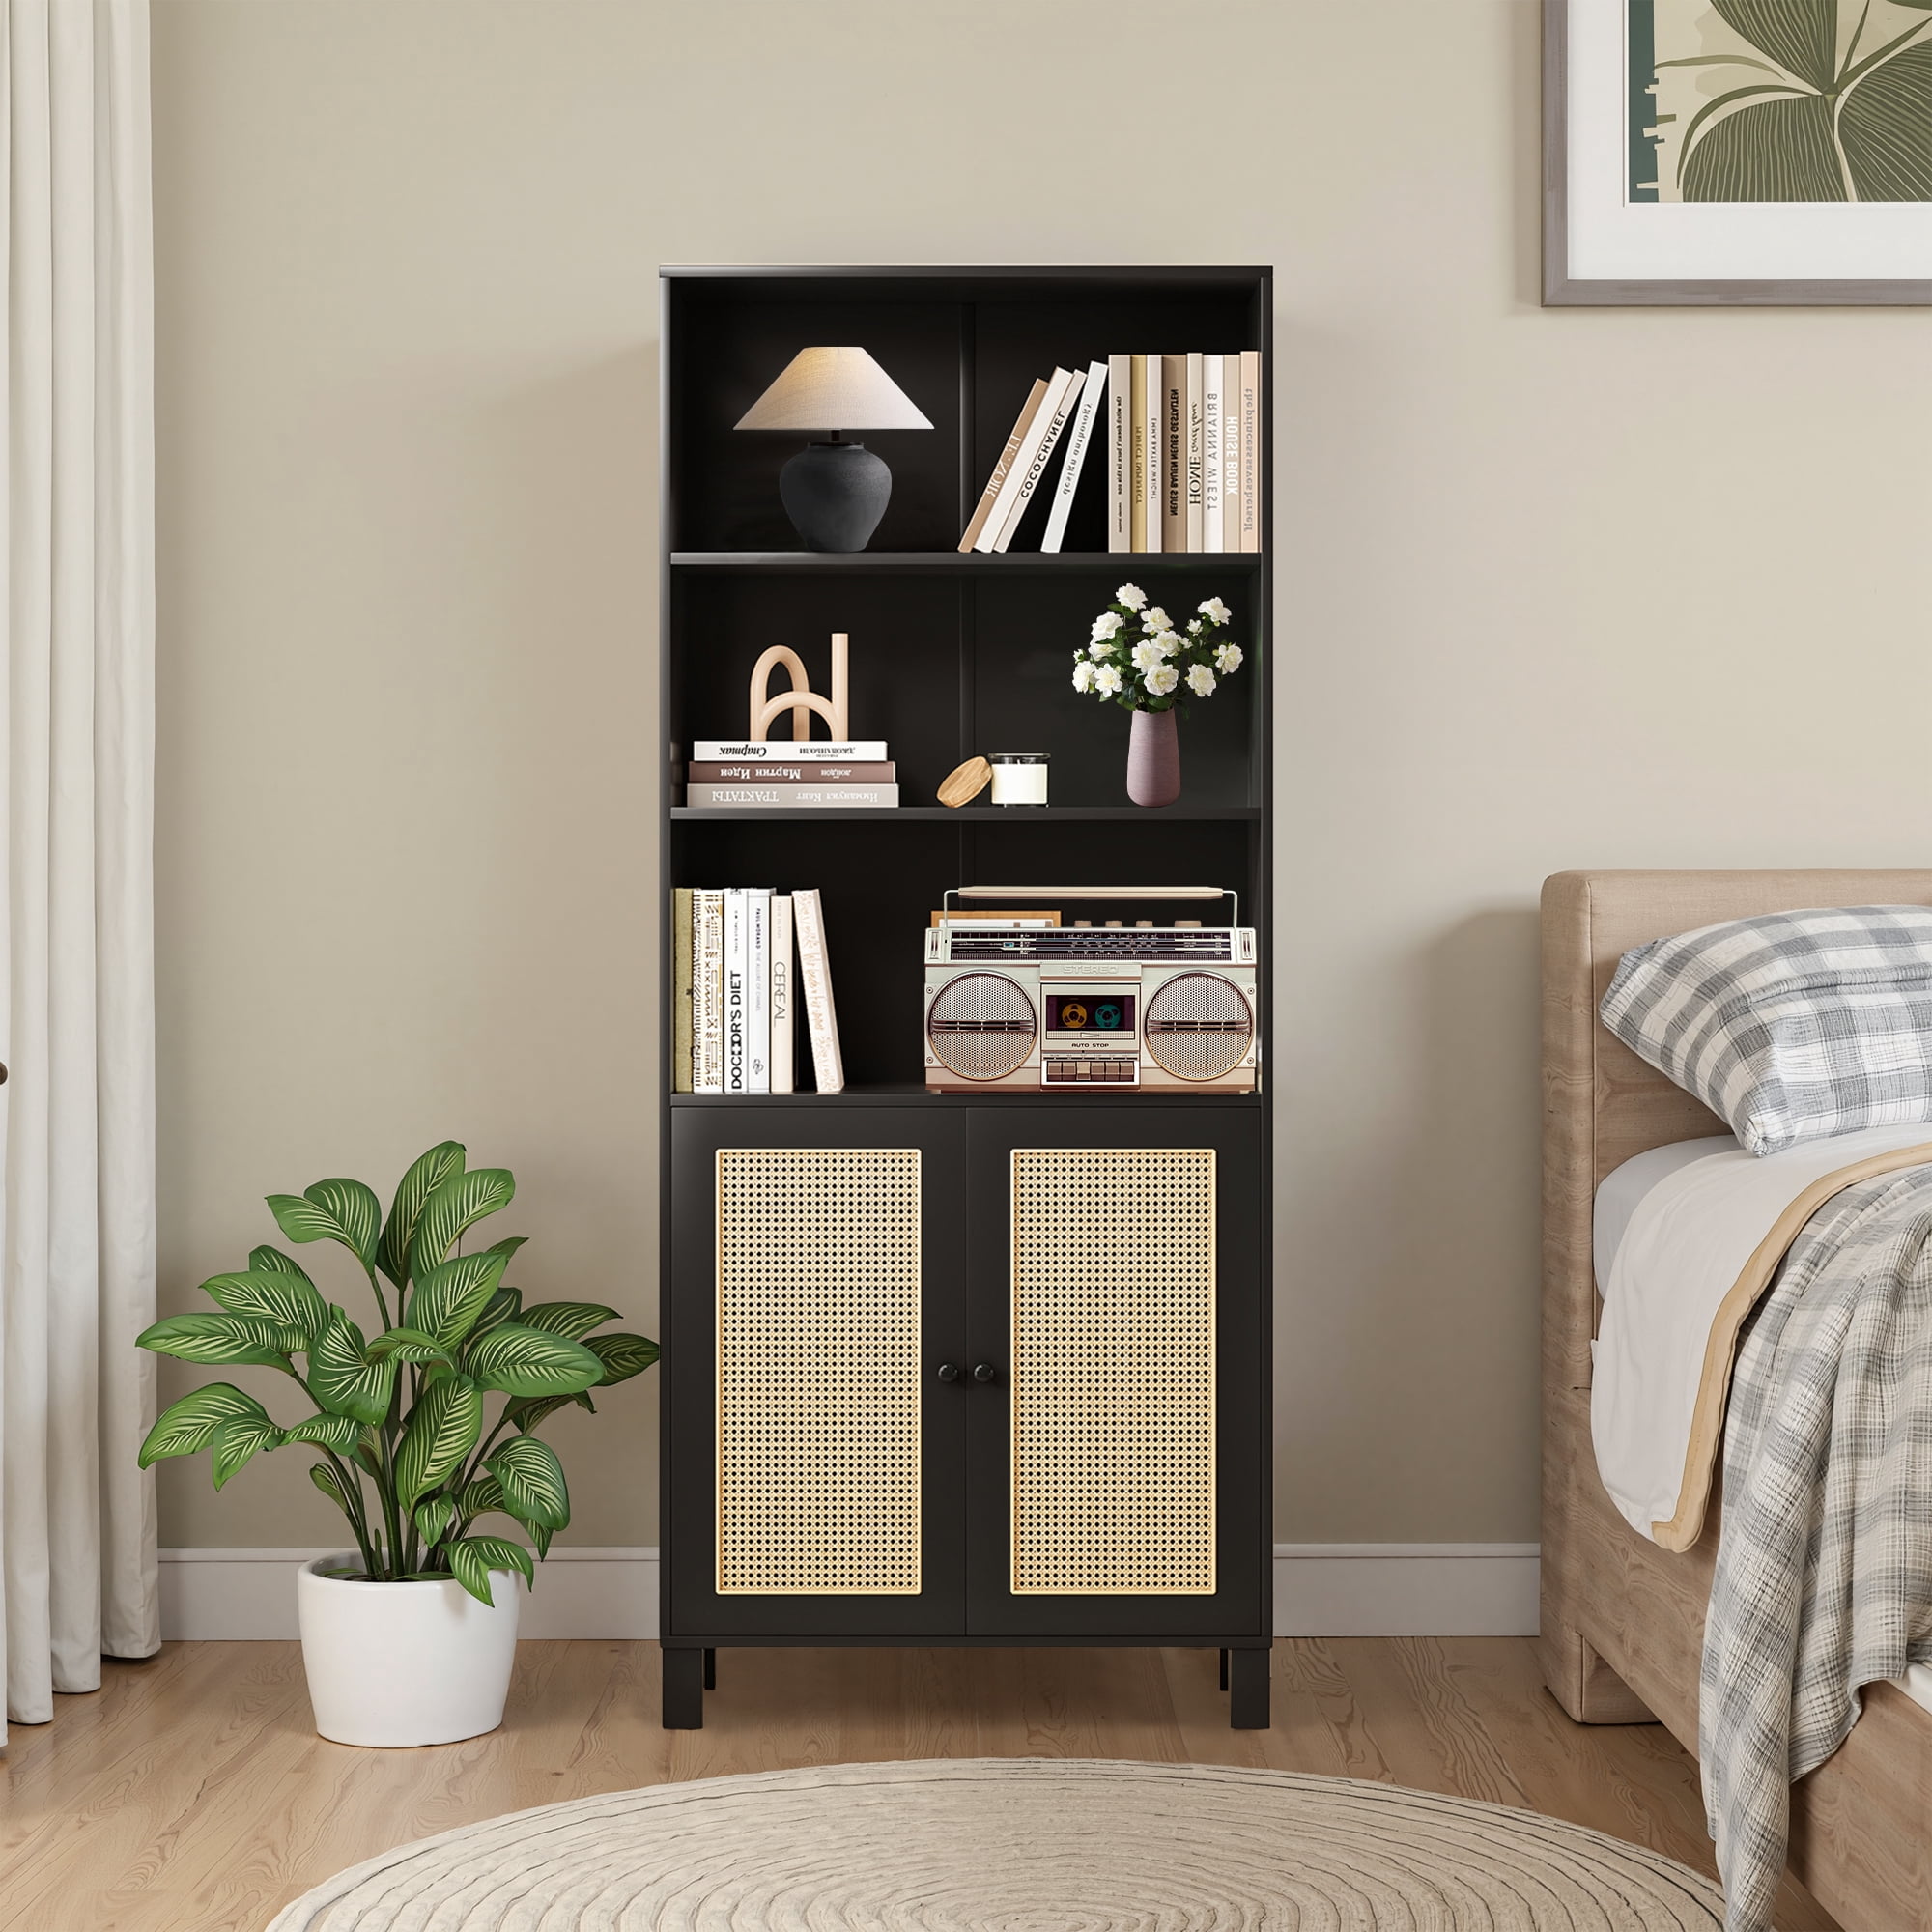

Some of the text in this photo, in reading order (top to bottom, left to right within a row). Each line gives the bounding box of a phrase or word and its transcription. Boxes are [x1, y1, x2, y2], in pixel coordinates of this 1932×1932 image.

[719, 745, 767, 757] Спартак
[720, 766, 802, 780] Мартин Иден
[712, 790, 780, 802] ТРАКТАТЫ
[795, 792, 821, 802] Кант
[1062, 965, 1119, 975] STEREO
[730, 970, 741, 1005] DIET
[774, 961, 786, 1028] CEREAL
